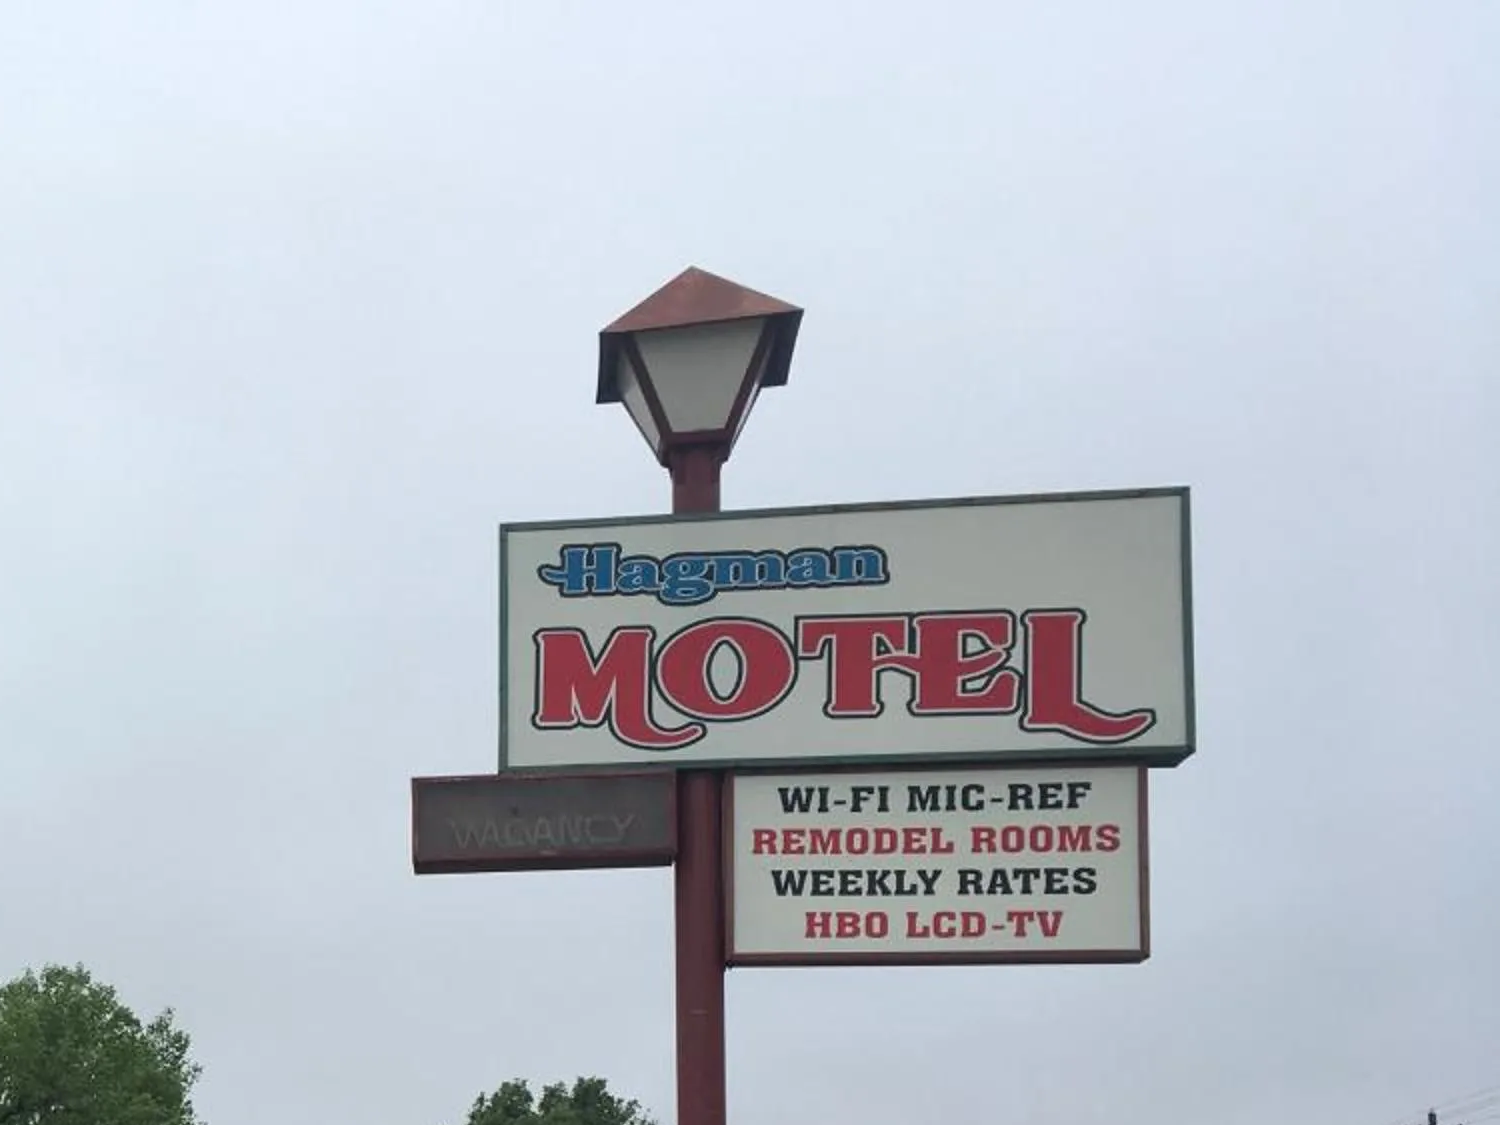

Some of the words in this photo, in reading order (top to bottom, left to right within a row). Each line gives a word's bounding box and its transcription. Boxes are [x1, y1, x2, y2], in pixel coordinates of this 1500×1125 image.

[537, 542, 890, 606] Hagman
[532, 608, 1156, 750] MOTEL
[778, 785, 889, 813] WI-FI
[907, 782, 1092, 812] MIC-REF
[752, 827, 954, 855] REMODEL
[971, 824, 1121, 853] ROOMS
[771, 868, 942, 896] WEEKLY
[957, 866, 1097, 895] RATES
[804, 911, 889, 938] HBO
[906, 910, 1063, 937] LCD-TV
